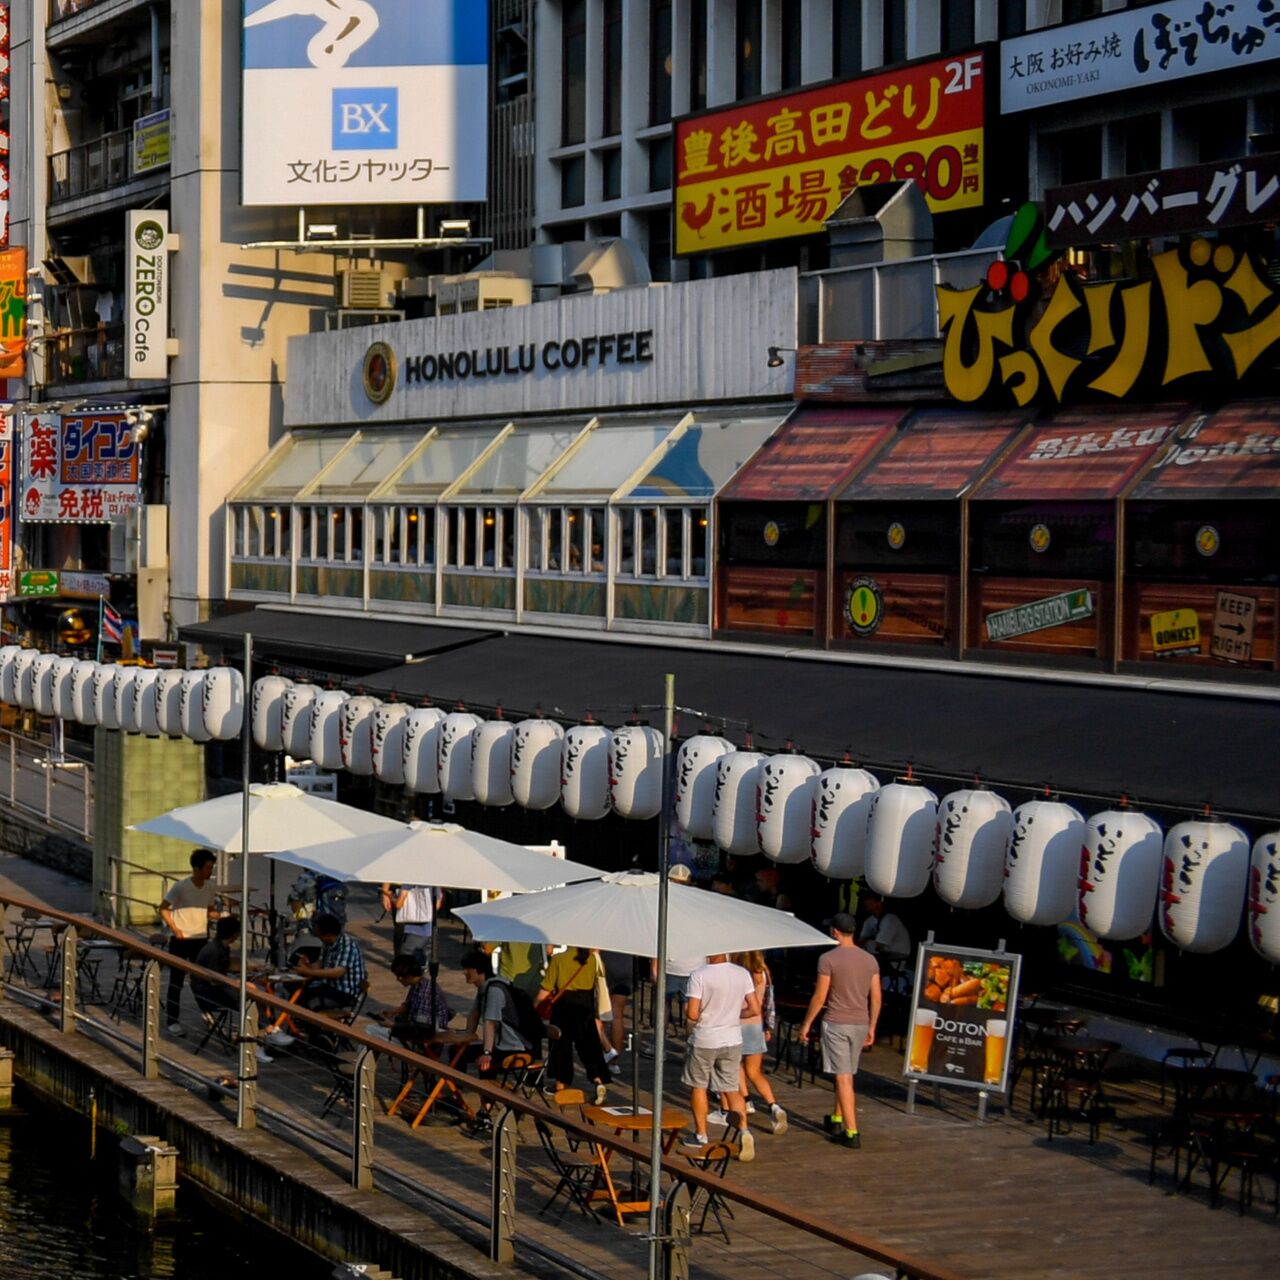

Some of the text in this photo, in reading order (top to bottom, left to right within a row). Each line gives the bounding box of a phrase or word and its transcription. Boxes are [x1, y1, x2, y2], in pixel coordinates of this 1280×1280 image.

[1009, 49, 1045, 81] 大阪
[1051, 31, 1123, 69] お好み焼
[1026, 70, 1101, 95] OKONOMI-YAKI
[340, 103, 391, 134] BX
[682, 53, 983, 173] 豊後高田どり 2F
[720, 169, 828, 233] 酒場
[963, 176, 979, 194] 円
[134, 254, 156, 362] ZERO Cafe
[936, 238, 1280, 408] びっくりドン
[406, 329, 654, 384] HONOLULU COFFEE
[30, 417, 58, 479] 薬
[65, 419, 136, 461] ダイコク
[59, 487, 104, 519] 免税
[1031, 597, 1071, 628] STATION
[1219, 598, 1252, 616] KEEP
[1156, 626, 1197, 645] DONKEY
[1213, 635, 1251, 658] RIGHT
[933, 1016, 989, 1038] DOTON
[936, 1032, 959, 1045] CAFE
[964, 1036, 982, 1048] BAR
